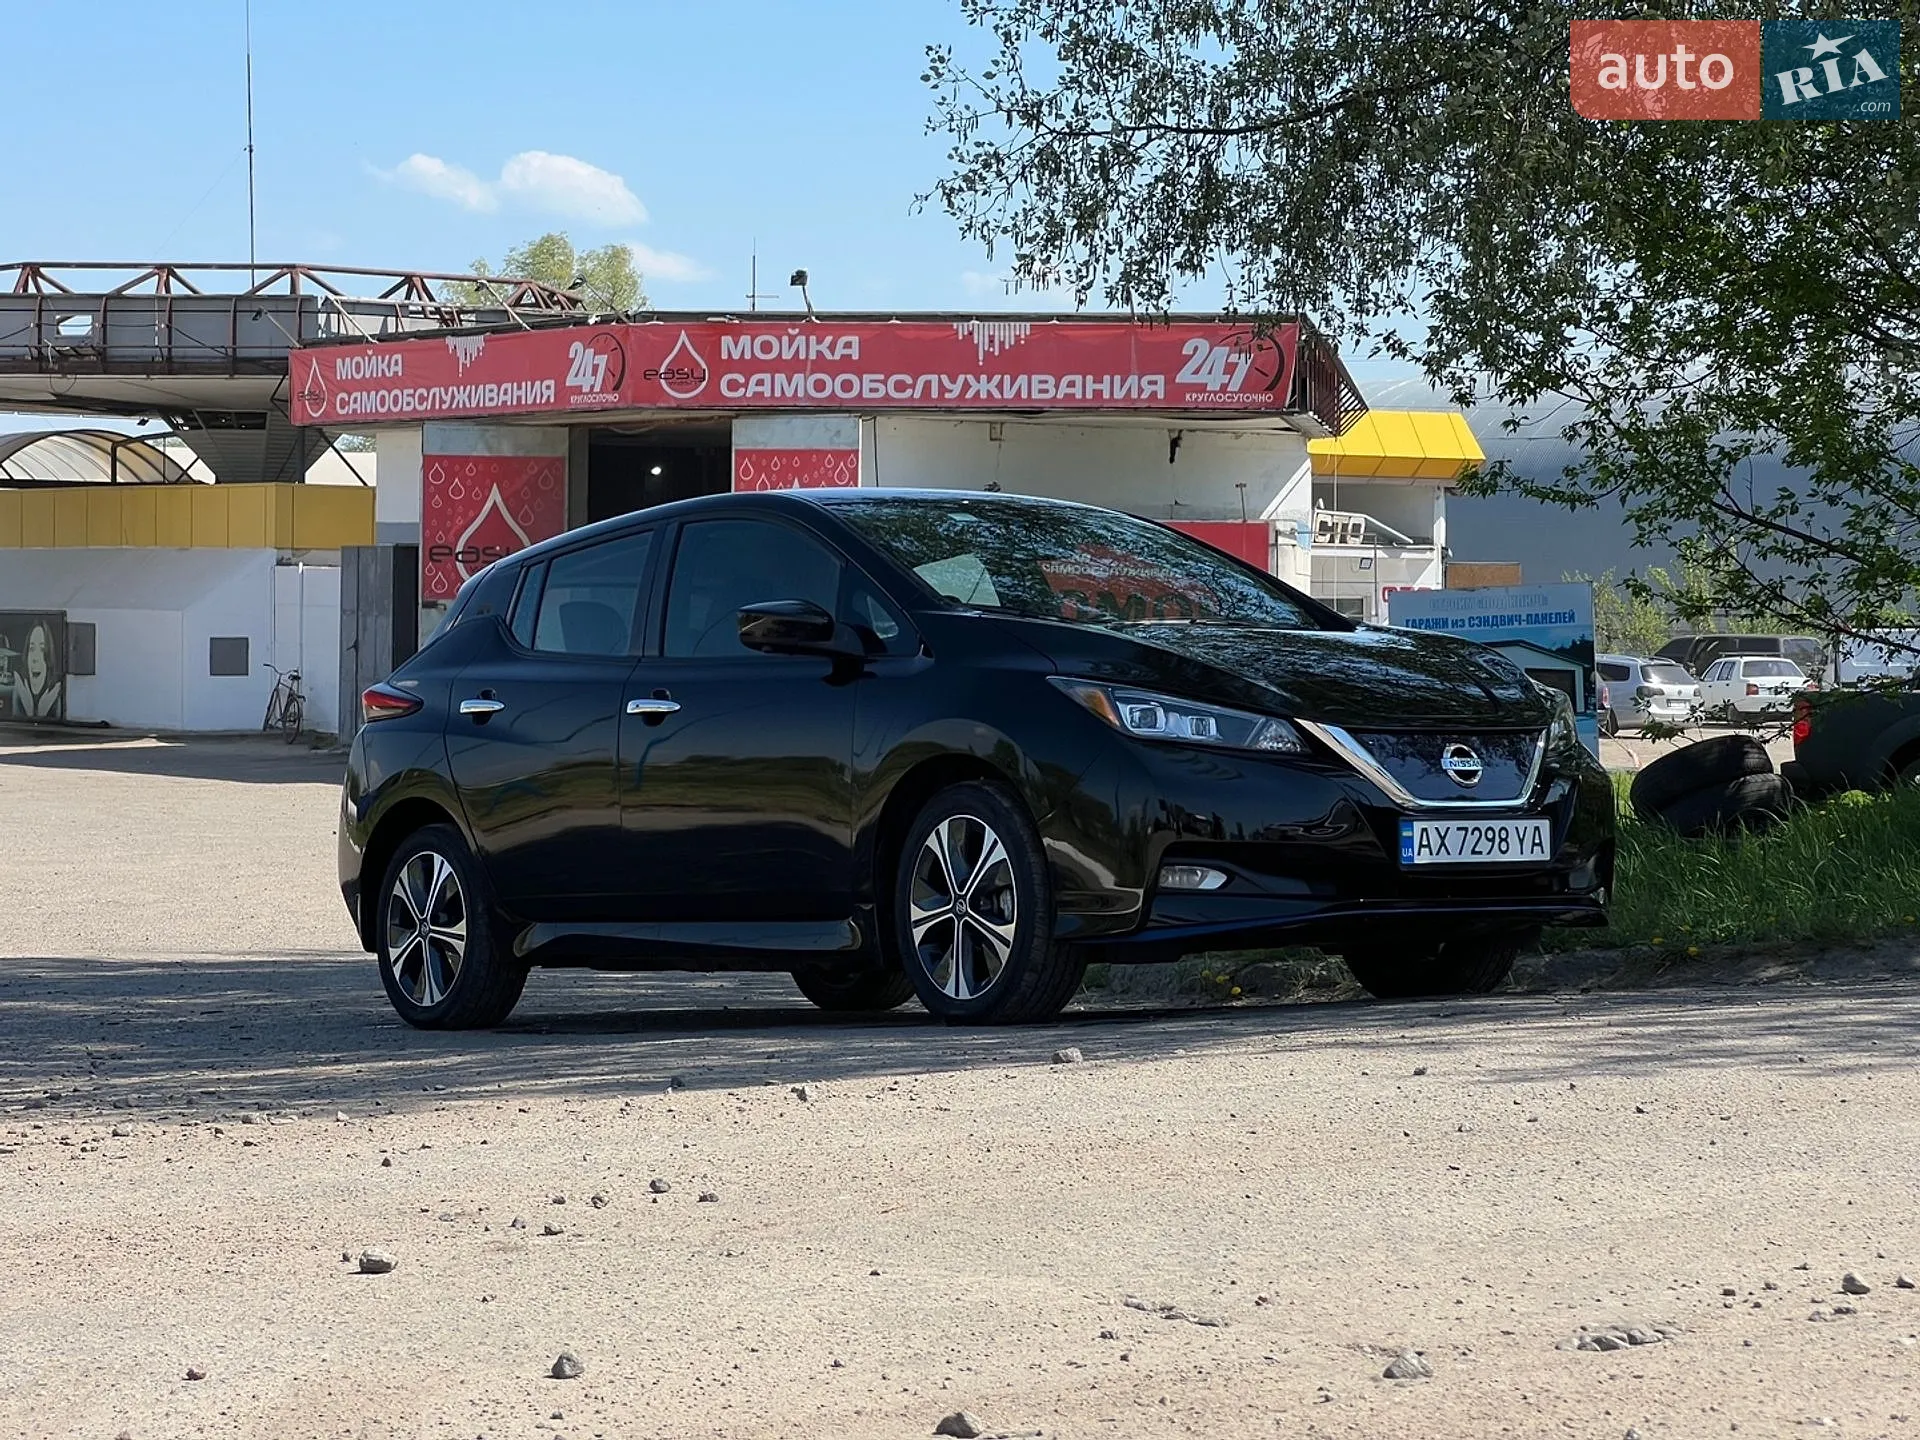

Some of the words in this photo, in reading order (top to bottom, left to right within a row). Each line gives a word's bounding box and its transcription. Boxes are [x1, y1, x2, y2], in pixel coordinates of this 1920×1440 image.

[720, 328, 860, 360] МОЙКА
[336, 349, 403, 381] МОЙКА
[643, 366, 706, 383] easy
[335, 379, 556, 415] САМООБСЛУЖИВАНИЯ
[719, 373, 1166, 399] САМООБСЛУЖИВАНИЯ
[1185, 392, 1274, 403] КРУГЛОСУТОЧНО
[1314, 513, 1366, 545] СТО
[1405, 616, 1449, 630] ГАРАЖИ
[1451, 619, 1465, 629] из
[1468, 608, 1576, 630] СЭНДВИЧ-ПАНЕЛЕЙ
[1448, 759, 1483, 768] NISSAN
[1417, 826, 1450, 856] AX
[1456, 826, 1510, 856] 7298
[1515, 825, 1545, 855] YA
